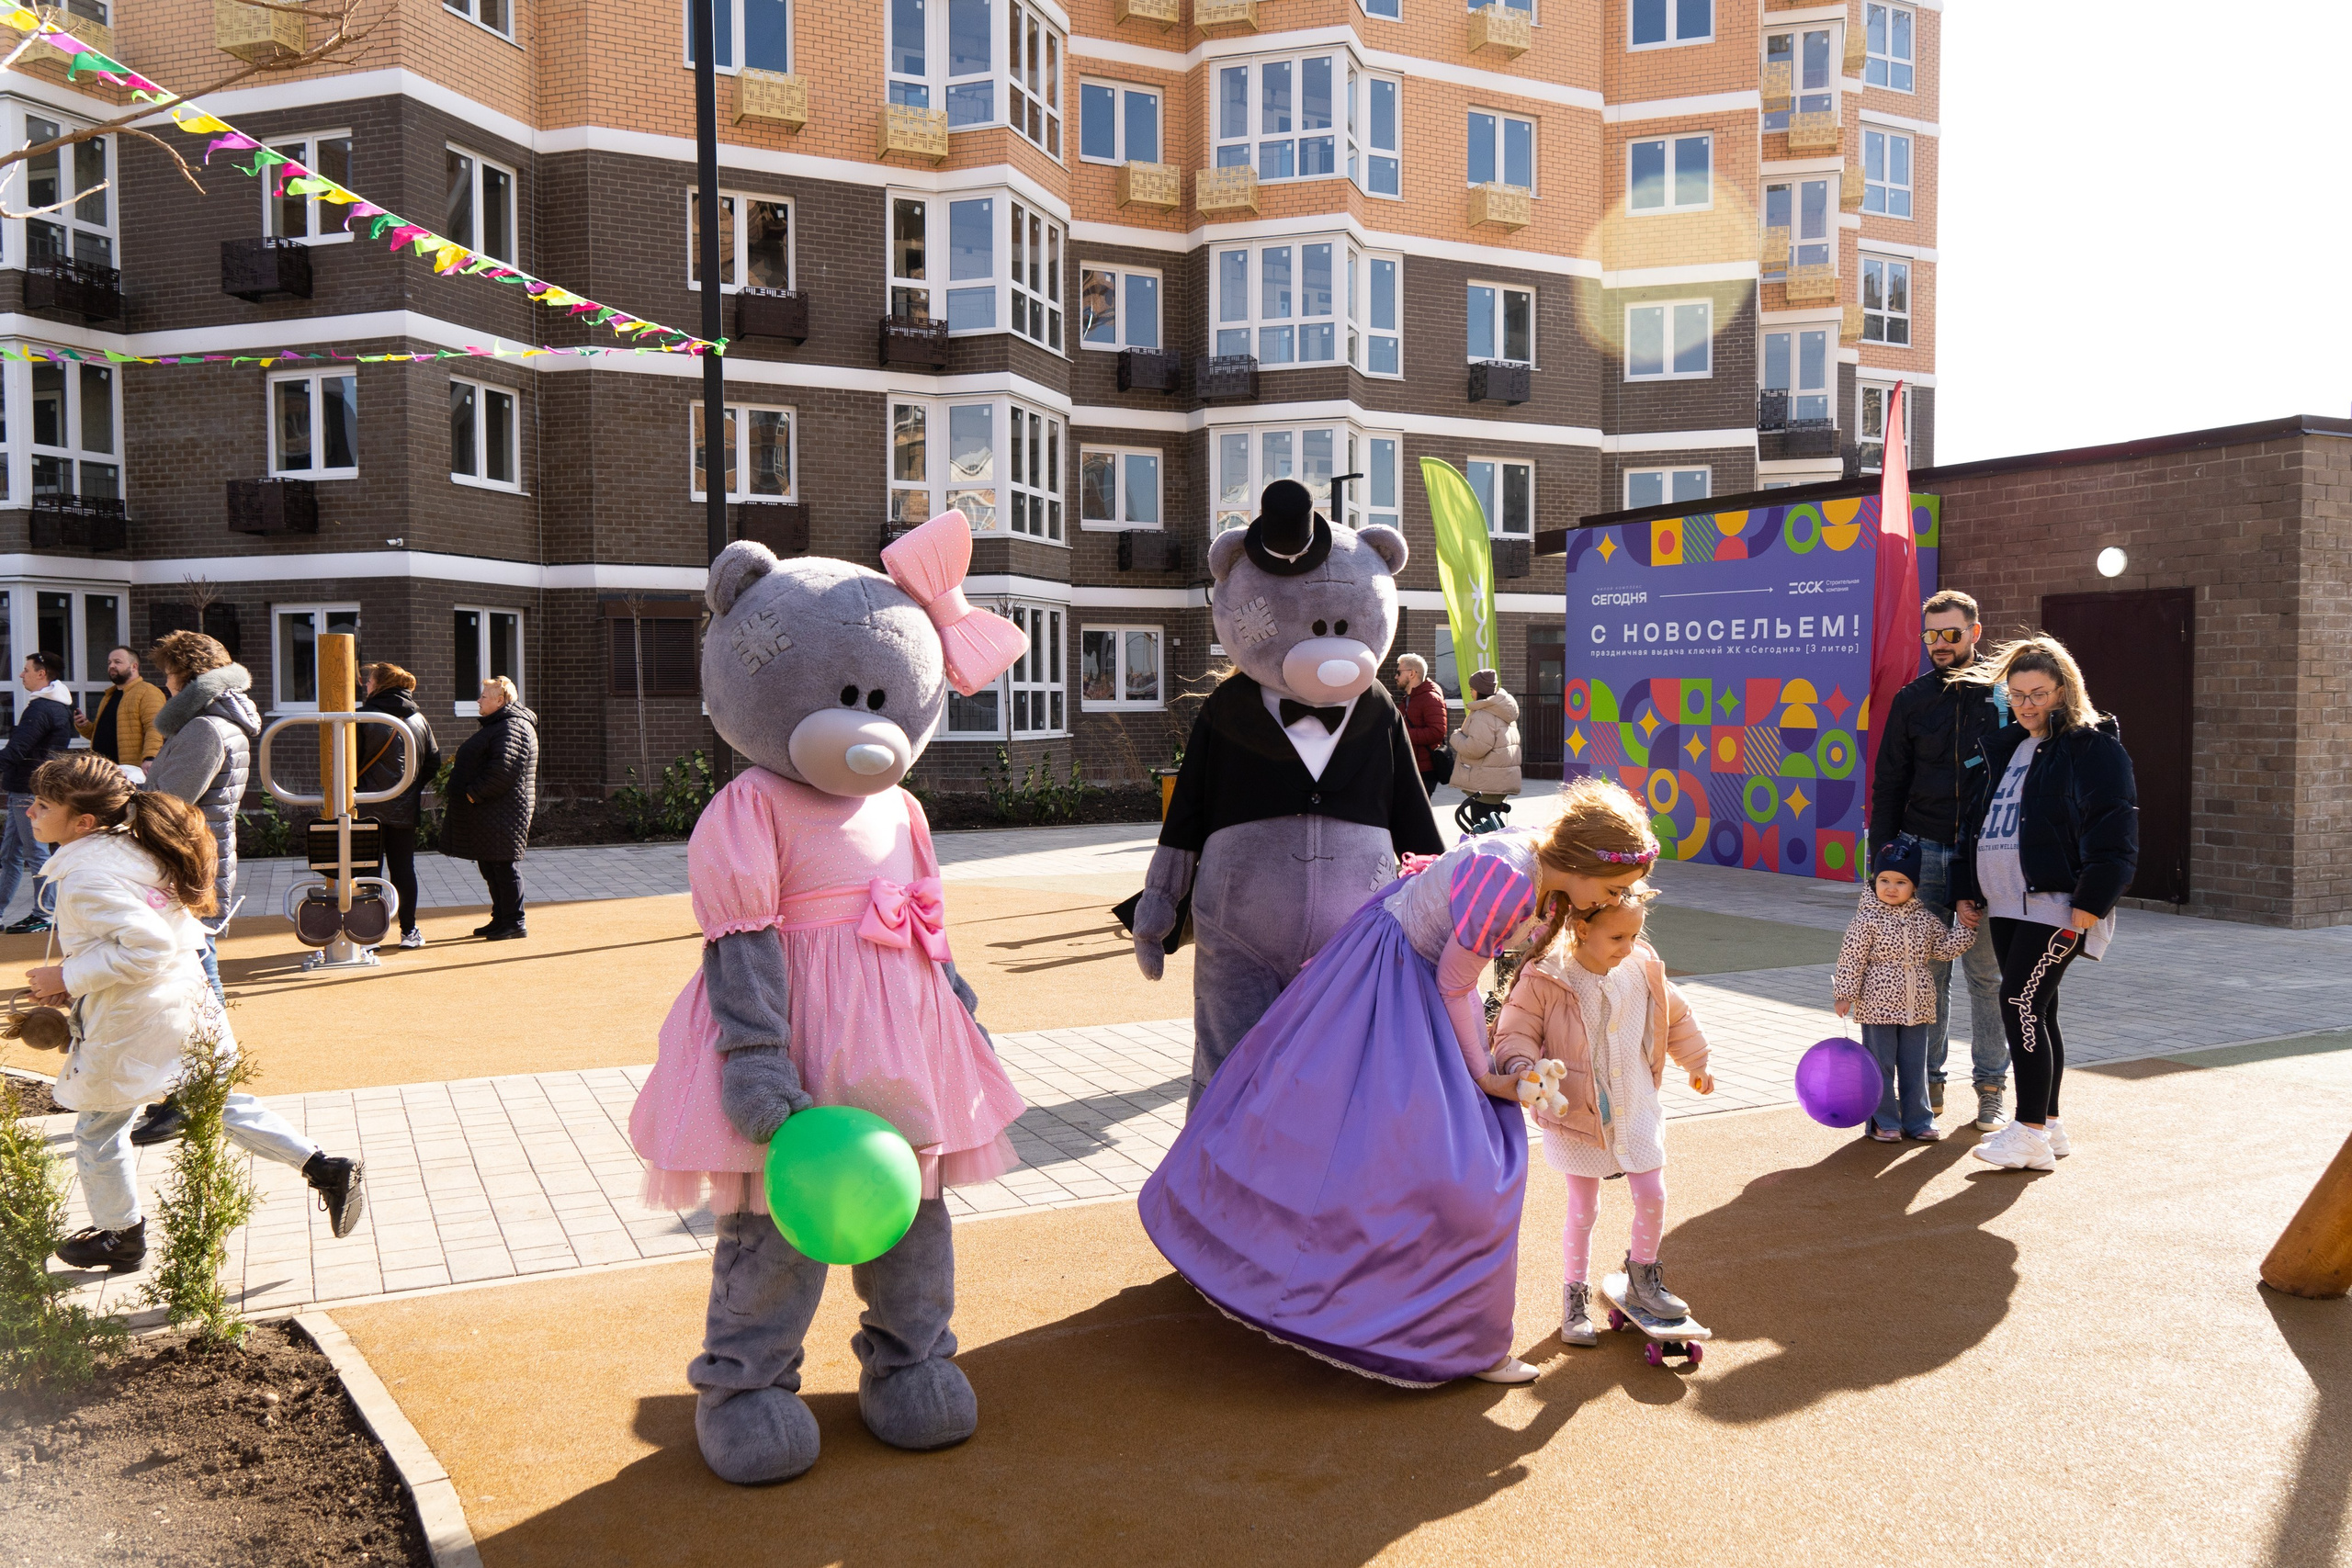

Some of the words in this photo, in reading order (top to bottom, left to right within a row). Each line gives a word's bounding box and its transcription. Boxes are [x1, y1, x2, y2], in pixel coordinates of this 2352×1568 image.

[1591, 592, 1647, 606] СЕГОДНЯ
[1591, 625, 1606, 643] С
[1623, 615, 1859, 643] НОВОСЕЛЬЕМ!
[1590, 649, 1647, 658] праздничная
[1651, 648, 1684, 657] выдача
[1688, 646, 1723, 655] ключей
[1726, 646, 1741, 654] ЖК
[1746, 645, 1801, 654] «Сегодня»
[1821, 643, 1859, 654] литер]
[2008, 927, 2078, 1053] Champion
